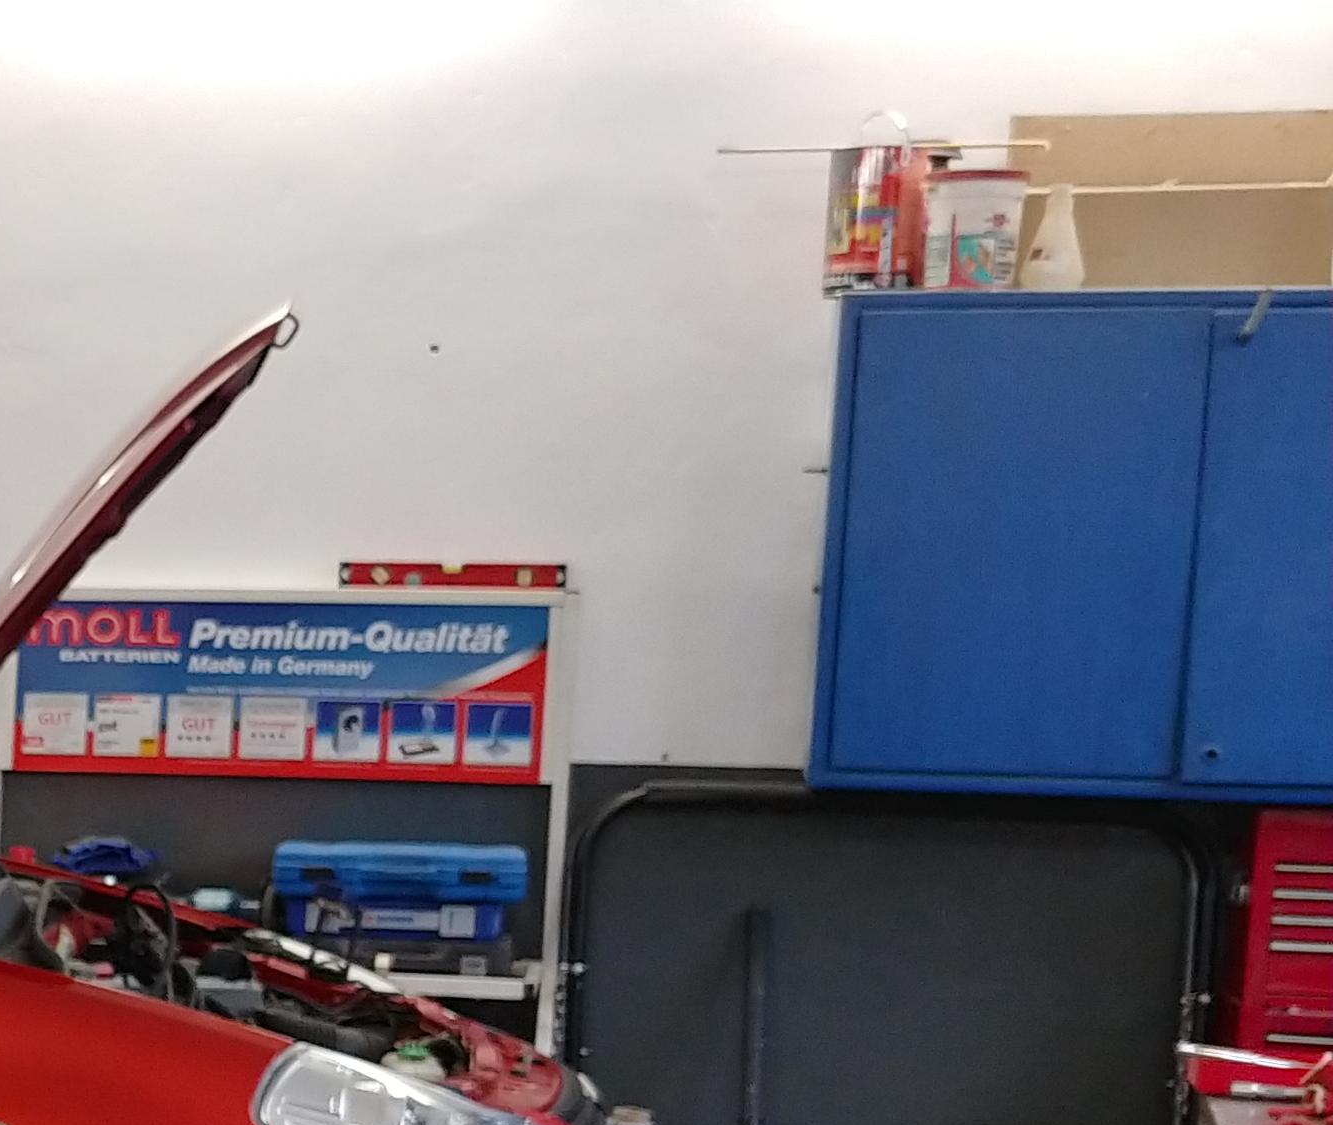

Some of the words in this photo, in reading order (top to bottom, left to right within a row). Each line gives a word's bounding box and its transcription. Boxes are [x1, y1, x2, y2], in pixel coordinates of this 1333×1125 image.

[188, 618, 511, 653] Premium-Qualität
[59, 649, 181, 664] BATTERIEN
[187, 654, 246, 675] Made
[250, 655, 273, 675] in
[278, 656, 374, 680] Germany
[181, 717, 216, 732] GUT
